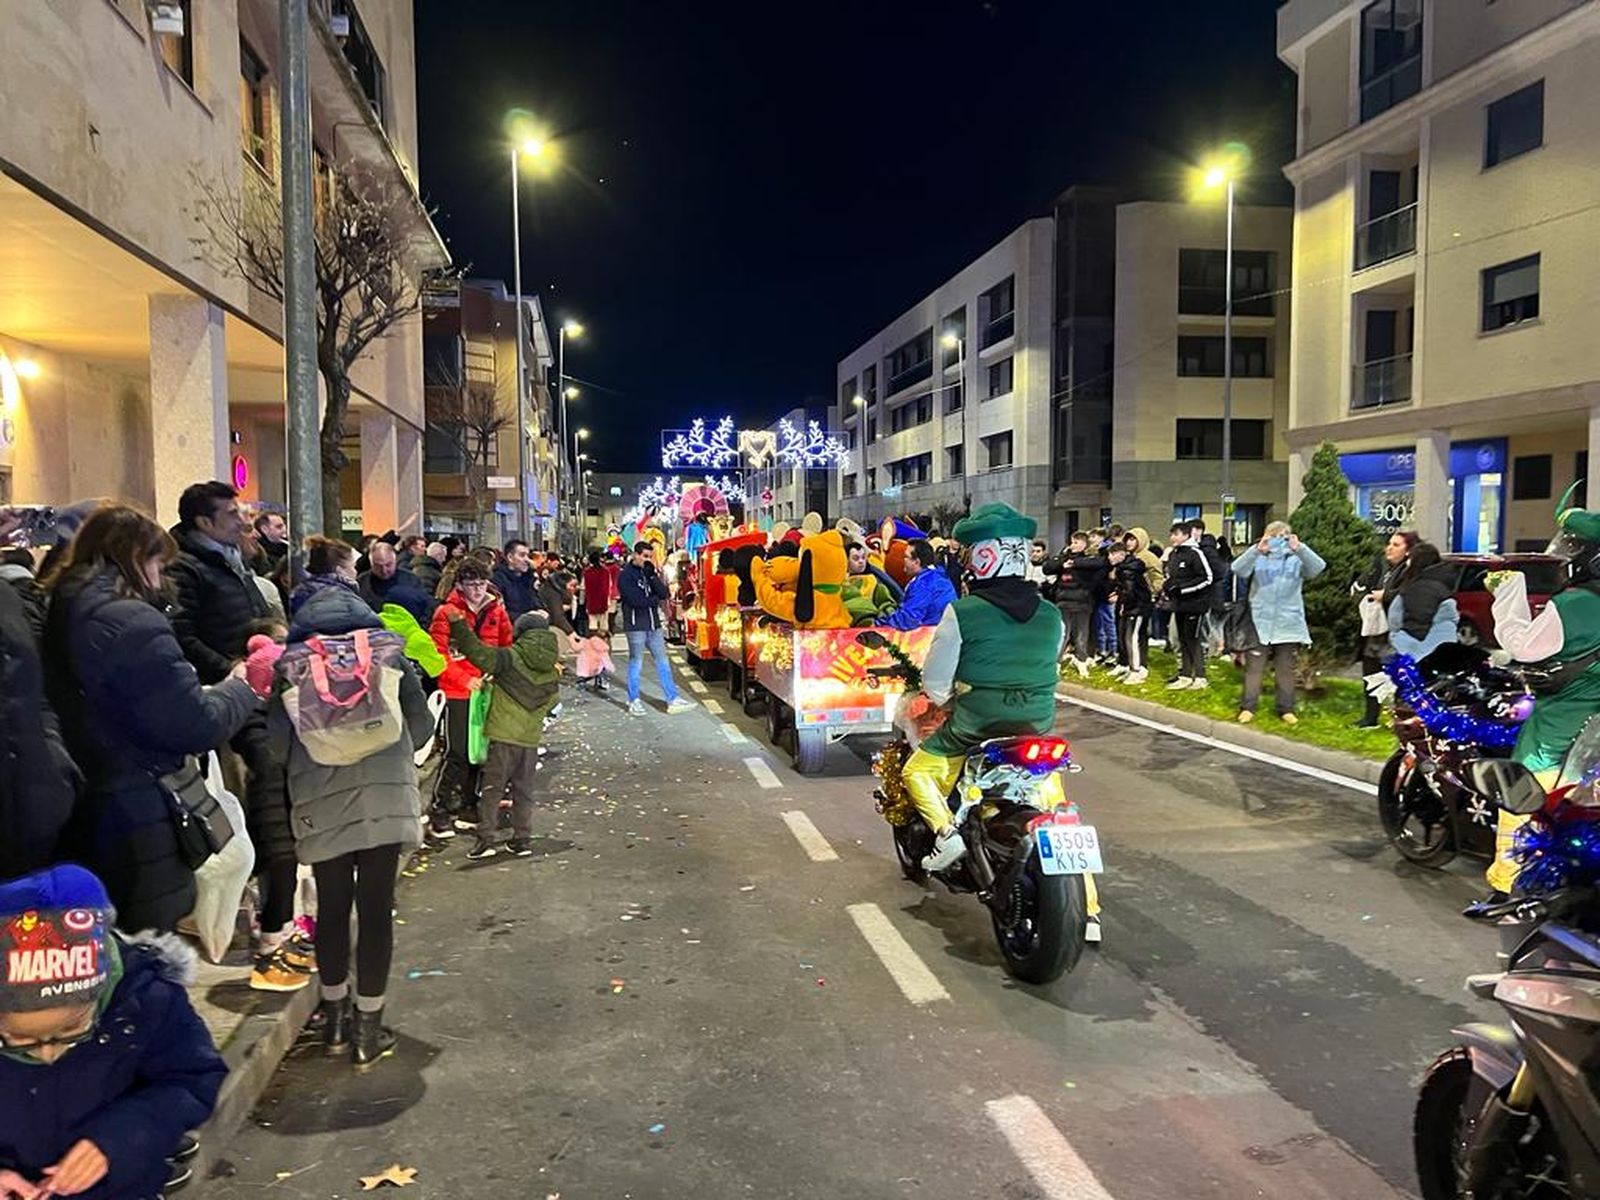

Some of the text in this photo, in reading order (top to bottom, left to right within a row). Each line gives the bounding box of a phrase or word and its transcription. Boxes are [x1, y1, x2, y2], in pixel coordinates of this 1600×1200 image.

[1053, 832, 1095, 850] 3509
[1056, 851, 1089, 870] KYS
[8, 943, 96, 983] MARVEL
